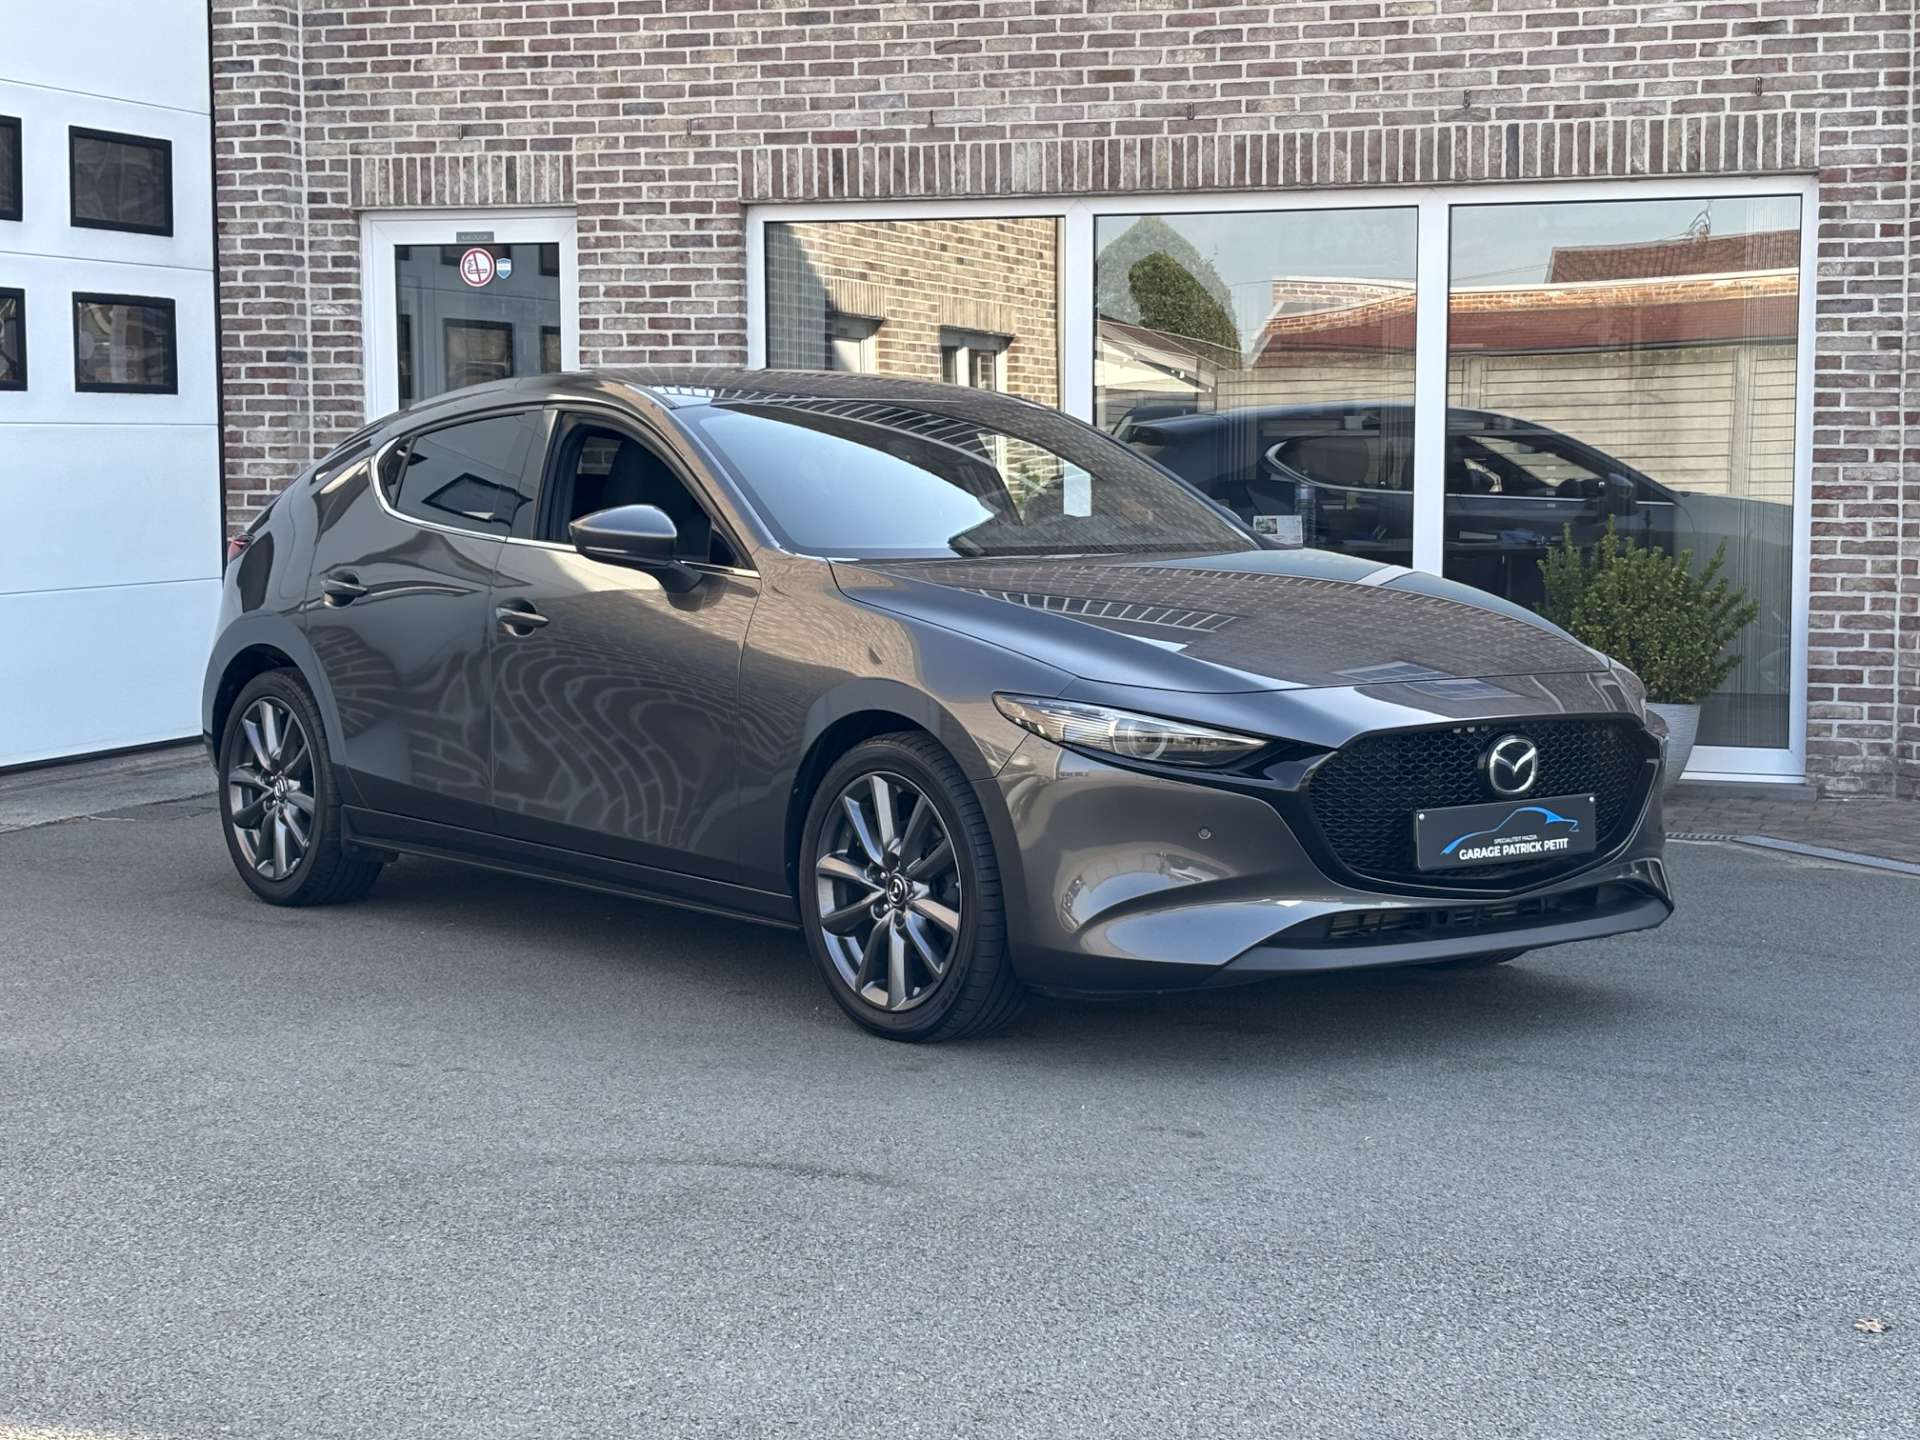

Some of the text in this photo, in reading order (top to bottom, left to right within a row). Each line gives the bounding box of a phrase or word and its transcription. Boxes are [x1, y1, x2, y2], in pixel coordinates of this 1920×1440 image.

[1458, 838, 1569, 860] GARAGE PATRICK PETIT
